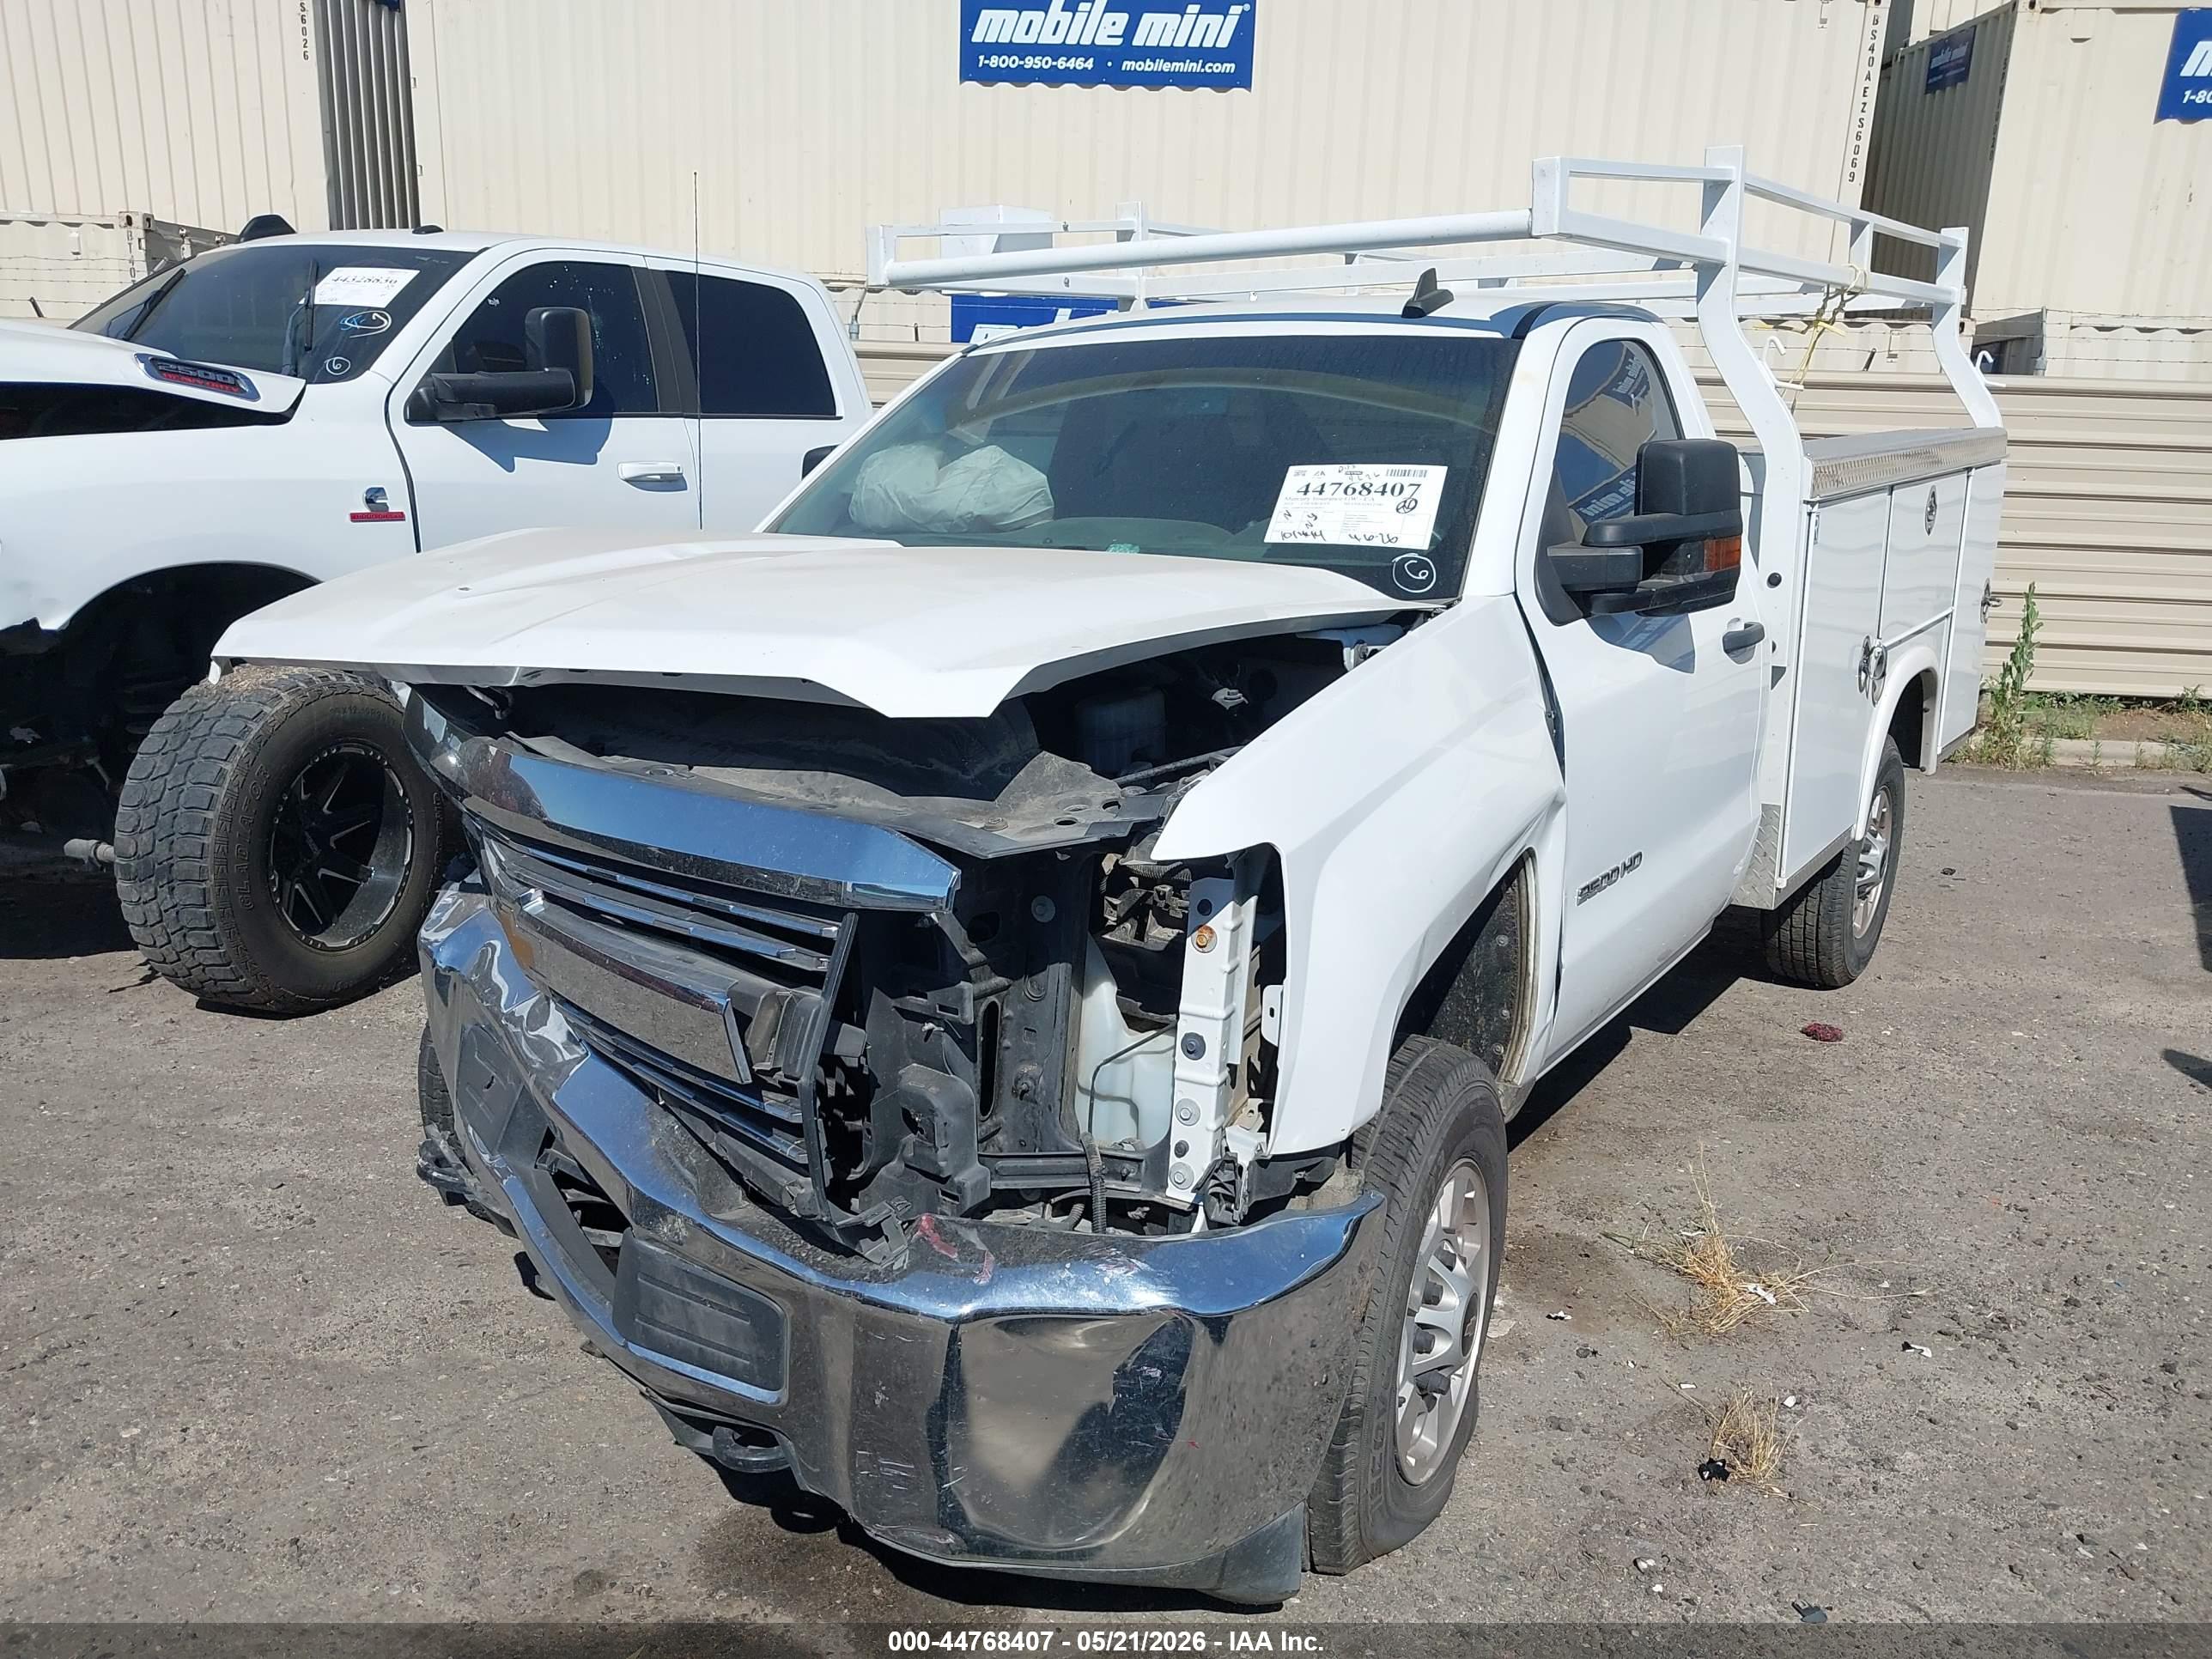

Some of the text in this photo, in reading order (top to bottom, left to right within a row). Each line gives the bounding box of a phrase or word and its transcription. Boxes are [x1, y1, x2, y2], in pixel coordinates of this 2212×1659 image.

[971, 0, 1129, 46] mobile
[978, 55, 1236, 74] 1-800-950-6464 mobilemini.com
[1297, 482, 1422, 499] 44768407
